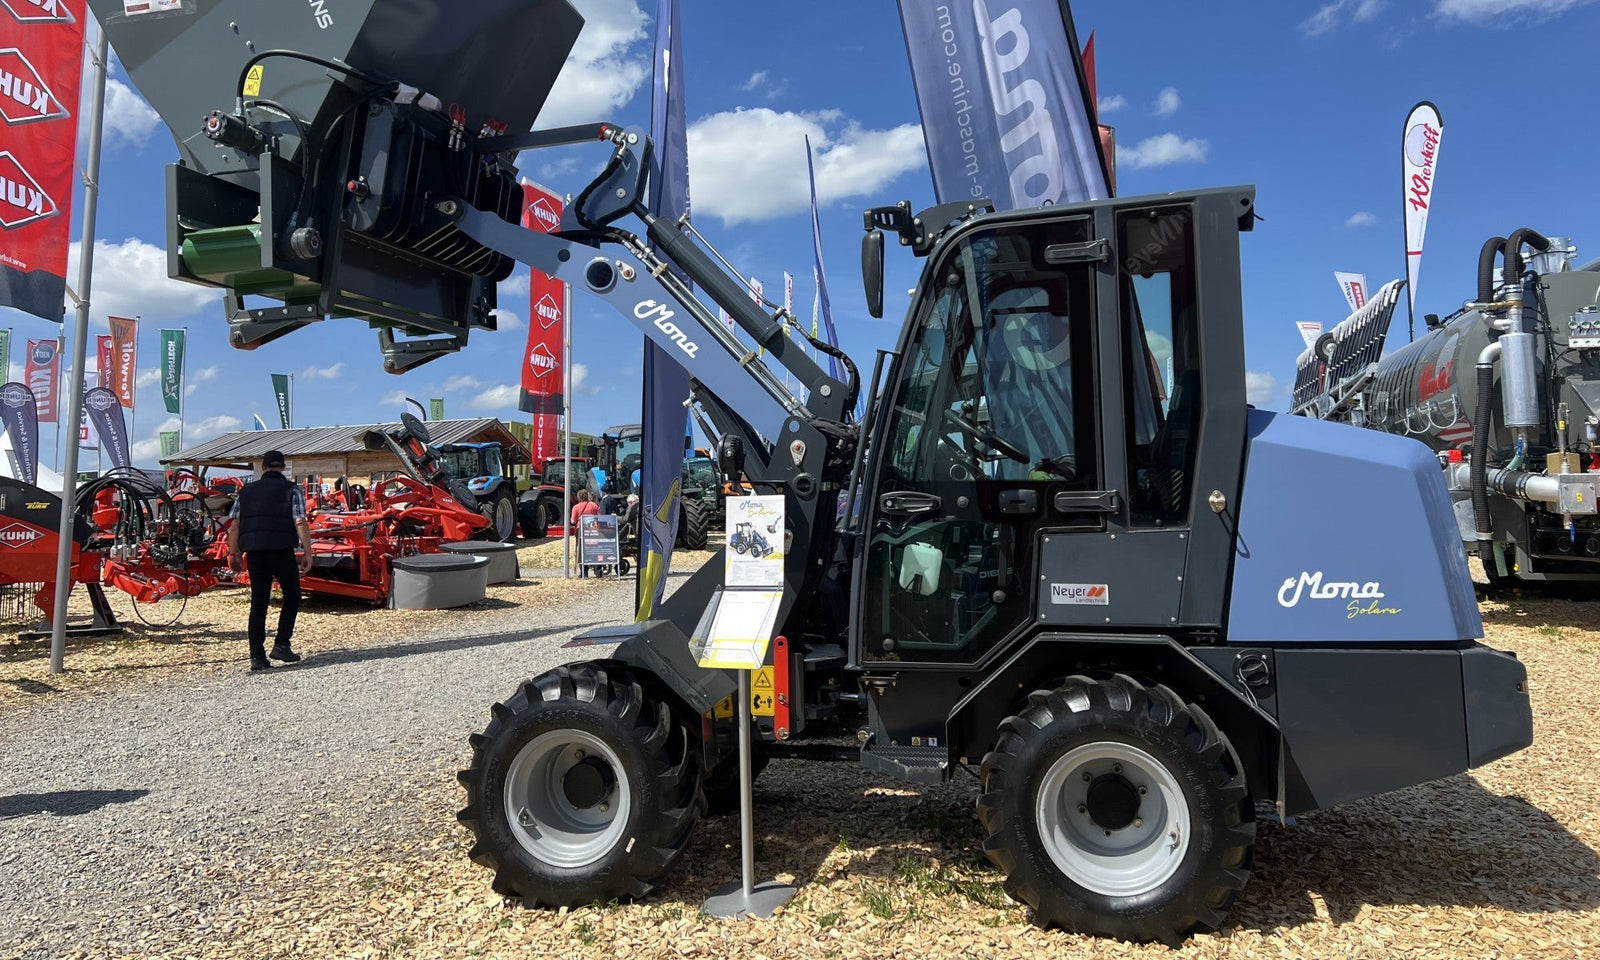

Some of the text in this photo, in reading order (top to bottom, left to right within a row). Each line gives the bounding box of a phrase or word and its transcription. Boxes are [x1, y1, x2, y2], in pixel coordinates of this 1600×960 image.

[309, 0, 334, 29] NS
[1409, 122, 1440, 212] Wienhoff
[633, 299, 699, 359] Mona
[1053, 585, 1086, 598] Neyer
[1277, 571, 1385, 608] Mona
[1347, 599, 1402, 619] Solara
